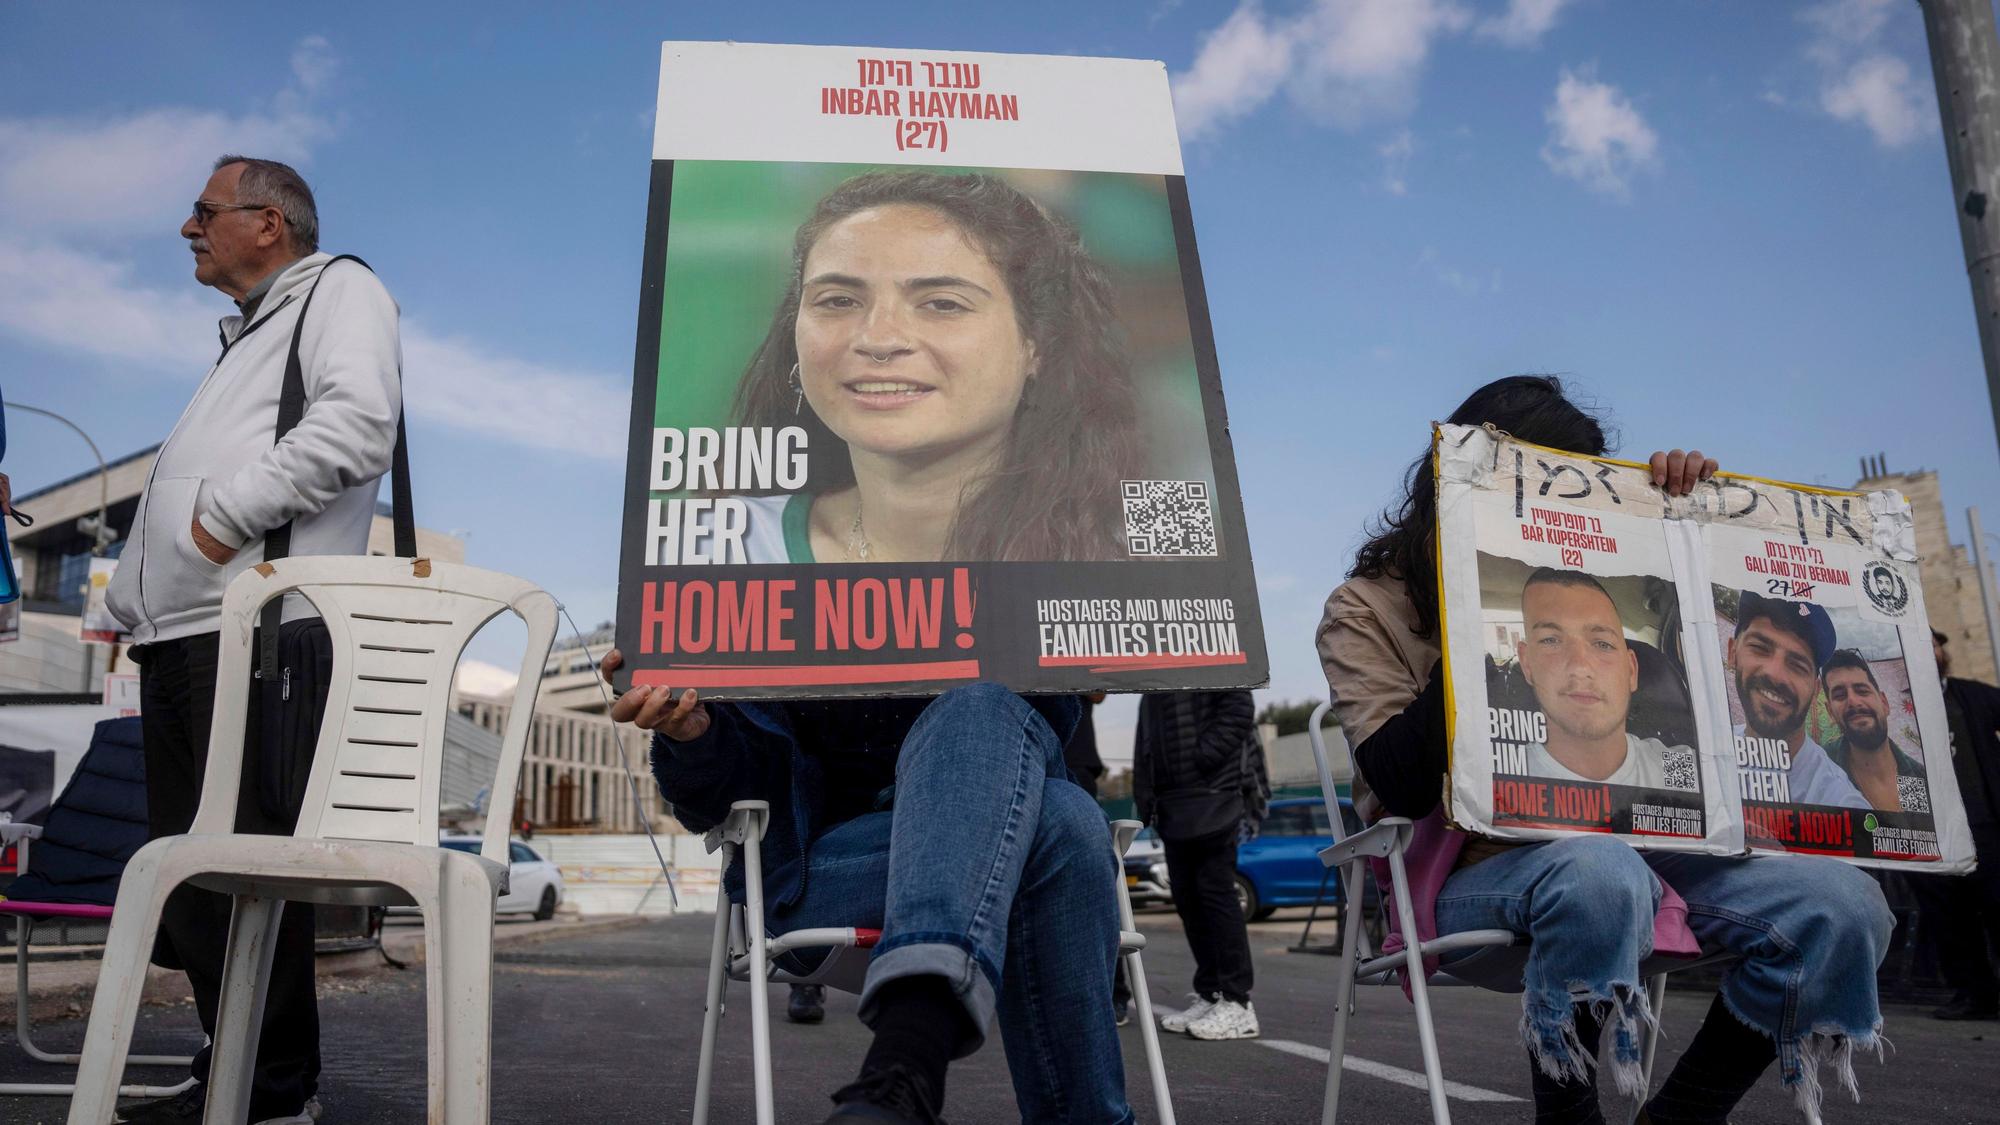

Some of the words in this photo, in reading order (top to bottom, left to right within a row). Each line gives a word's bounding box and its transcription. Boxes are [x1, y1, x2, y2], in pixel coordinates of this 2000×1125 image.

[857, 59, 913, 88] הימן
[921, 61, 981, 89] ענבר
[822, 88, 900, 116] INBAR
[909, 91, 1019, 121] HAYMAN
[896, 119, 948, 152] (27)
[649, 426, 809, 491] BRING
[1509, 448, 1622, 518] זמן
[644, 498, 748, 566] HER
[1531, 507, 1587, 533] קופרשטיין
[1588, 516, 1603, 534] בר
[1785, 489, 1865, 546] אין
[1521, 524, 1545, 543] BAR
[1546, 527, 1618, 554] KUPERSHTEIN
[1764, 540, 1788, 560] ברמן
[1561, 548, 1584, 568] (22)
[1744, 555, 1769, 574] GALI
[1770, 559, 1791, 577] AND
[1791, 562, 1807, 580] ZIV
[1808, 565, 1851, 587] BERMAN
[1807, 547, 1825, 565] גלי
[1766, 579, 1789, 597] 27
[639, 579, 796, 654] HOME
[813, 567, 979, 651] NOW!
[1037, 599, 1122, 622] HOSTAGES
[1126, 599, 1159, 621] AND
[1162, 599, 1235, 621] MISSING
[1039, 623, 1150, 658] FAMILIES
[1153, 622, 1240, 657] FORUM
[1488, 707, 1548, 744] BRING
[1490, 742, 1528, 776] HIM
[1734, 735, 1791, 770] BRING
[1493, 780, 1549, 817] HOME
[1553, 784, 1612, 824] NOW!
[1737, 771, 1790, 804] THEM
[1632, 803, 1662, 817] HOSTAGES
[1663, 806, 1675, 818] AND
[1675, 807, 1701, 820] MISSING
[1632, 815, 1670, 833] FAMILIES
[1671, 818, 1702, 837] FORUM
[1742, 806, 1796, 842] HOME
[1799, 810, 1853, 846] NOW!
[1873, 836, 1909, 855] FAMILIES
[1910, 840, 1941, 857] FORUM
[1901, 828, 1912, 840] AND
[1912, 829, 1937, 842] MISSING
